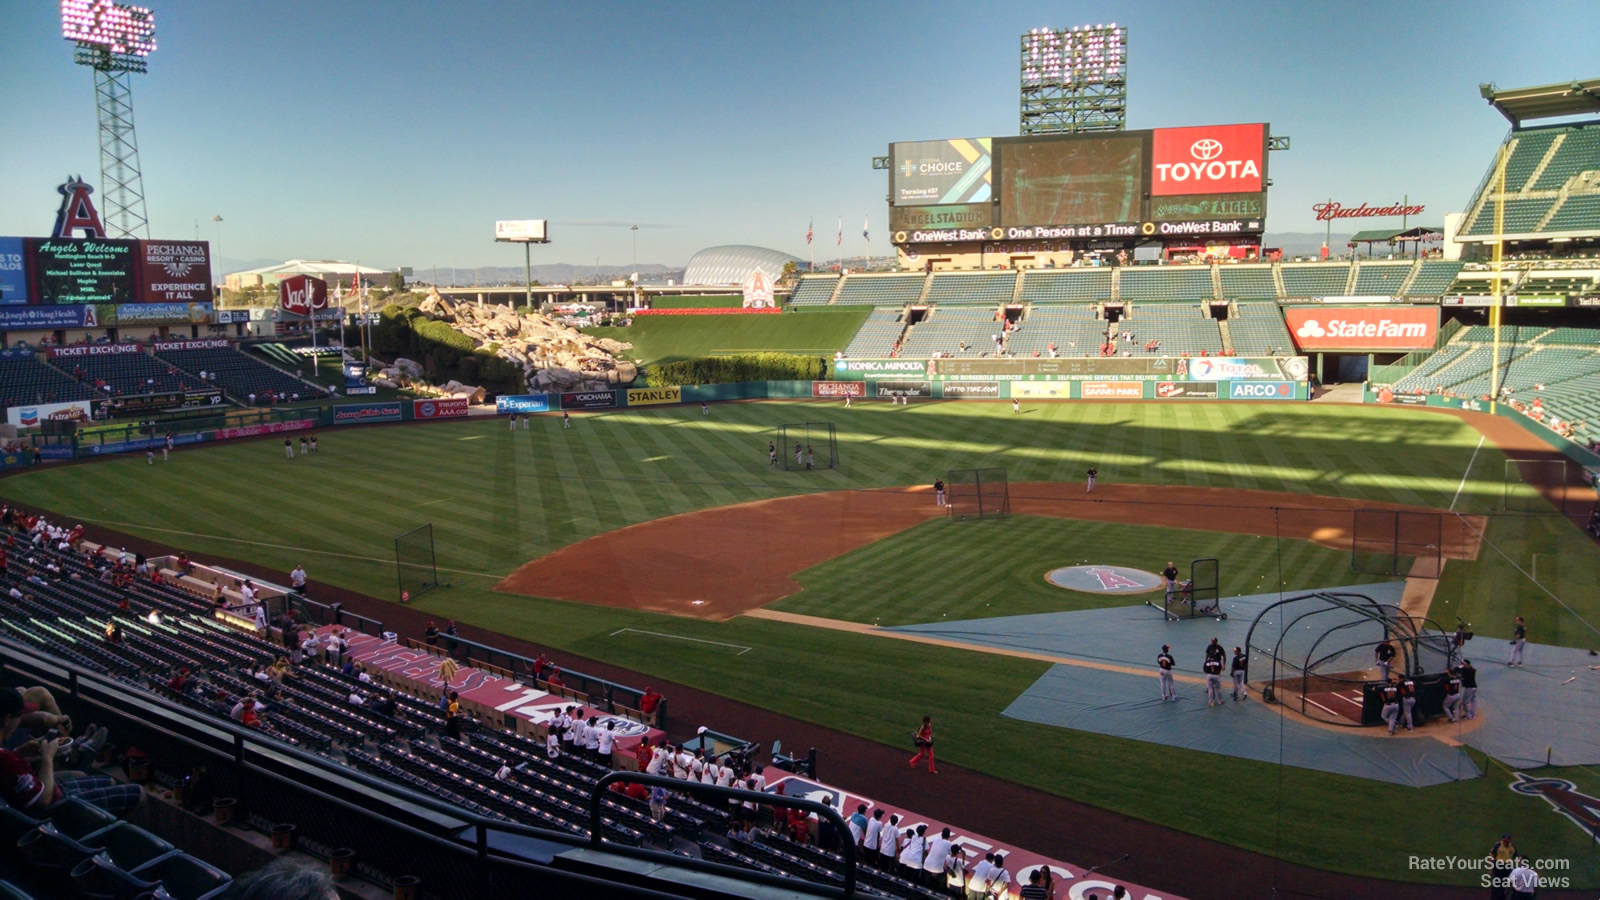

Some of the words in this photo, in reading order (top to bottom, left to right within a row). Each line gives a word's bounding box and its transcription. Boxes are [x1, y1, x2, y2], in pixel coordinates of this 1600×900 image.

[919, 162, 963, 173] CHOICE
[1156, 160, 1259, 182] TOYOTA
[900, 188, 927, 196] Turning
[1214, 199, 1260, 214] ANGELS
[1312, 201, 1425, 221] Budweiser
[903, 208, 935, 224] ANGEL
[1008, 228, 1032, 238] One
[1035, 226, 1075, 237] Person
[1078, 226, 1091, 236] at
[1094, 227, 1102, 235] a
[1104, 224, 1137, 235] Time
[1160, 221, 1210, 233] OneWest
[1212, 220, 1243, 232] Bank
[913, 230, 959, 242] OneWest
[960, 229, 986, 240] Bank
[39, 241, 78, 254] Angels
[82, 241, 129, 253] Welcome
[146, 245, 205, 256] PECHANGA
[8, 254, 22, 262] TO
[151, 283, 206, 291] EXPERIENCE
[284, 279, 326, 309] Jack
[155, 341, 184, 350] TICKET
[54, 347, 87, 356] TICKET
[848, 362, 884, 371] KONICA
[885, 361, 923, 370] MINOLTA
[1084, 388, 1115, 396] SAFARI
[1116, 388, 1139, 396] PARK
[1234, 384, 1276, 396] ARCO
[210, 395, 221, 405] yp
[575, 393, 613, 401] YOKOHAMA
[629, 390, 679, 402] STANLEY
[508, 399, 544, 410] Experian
